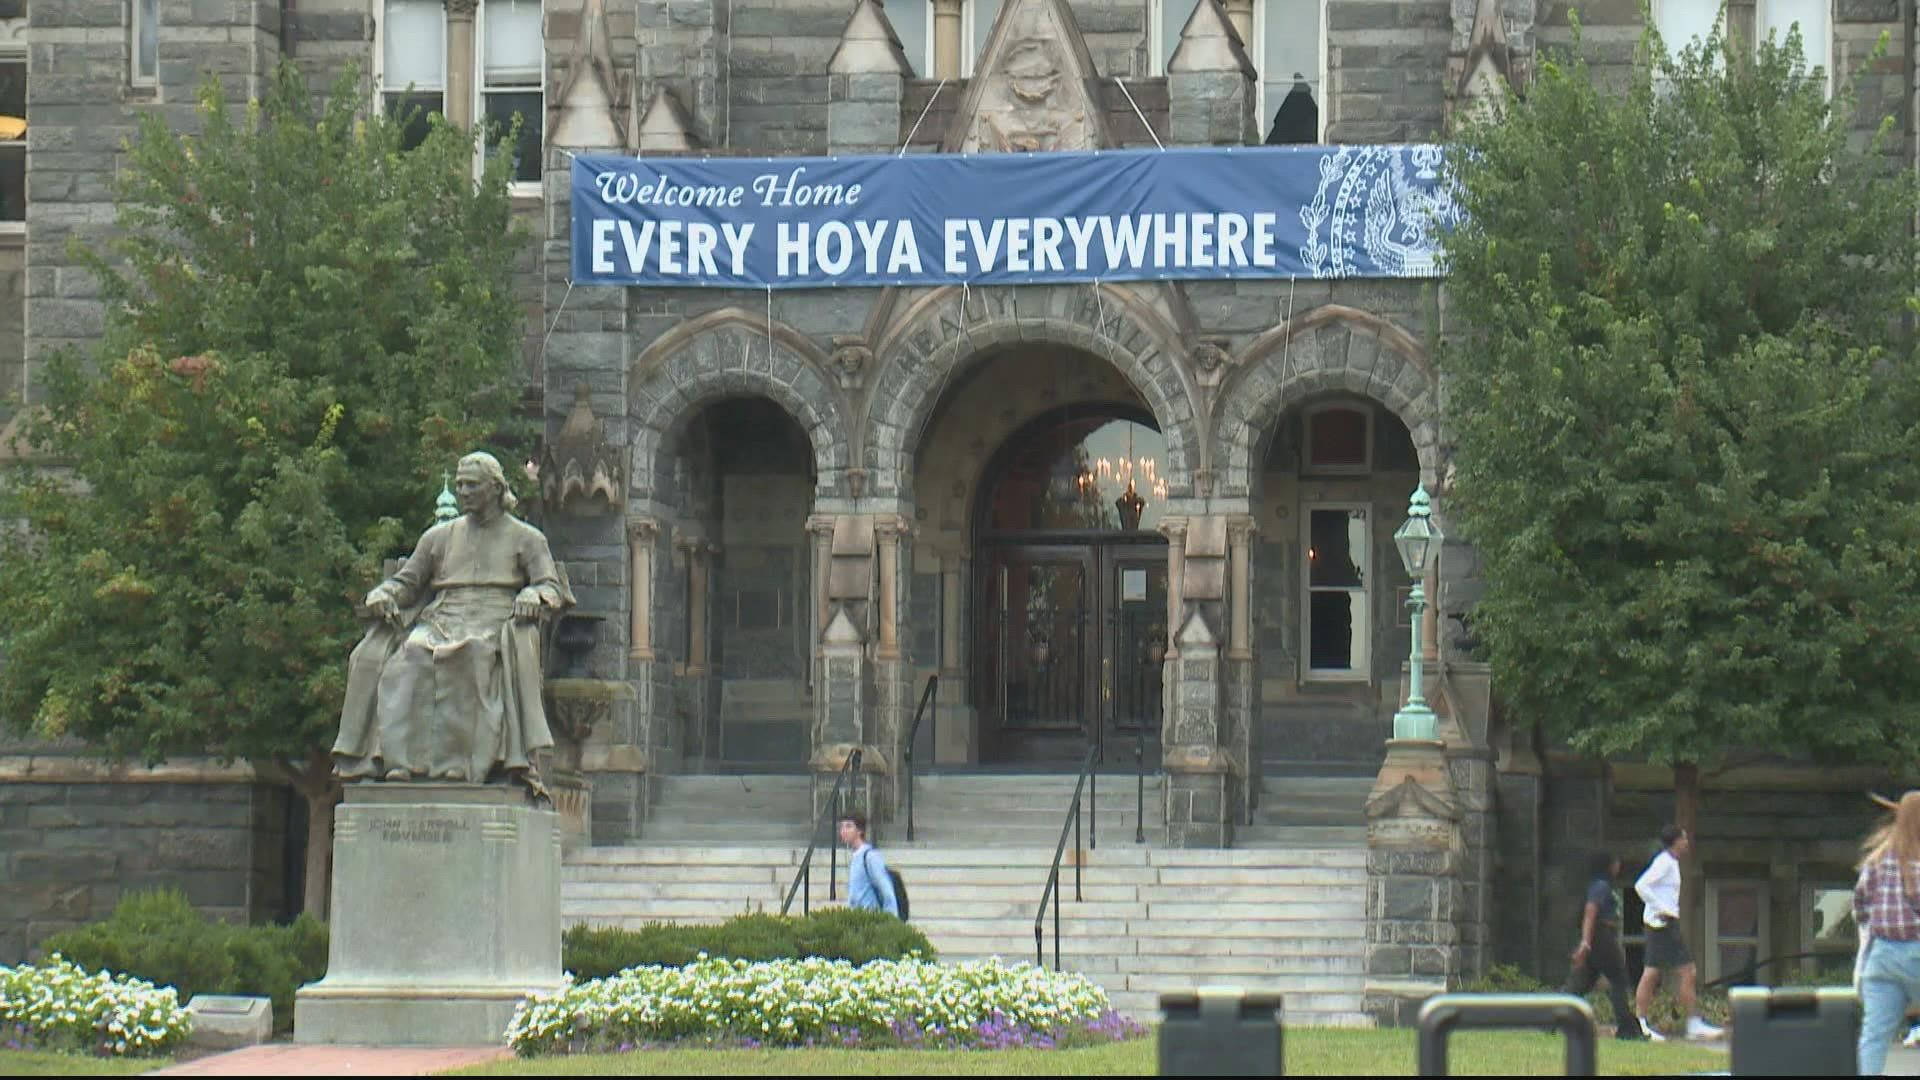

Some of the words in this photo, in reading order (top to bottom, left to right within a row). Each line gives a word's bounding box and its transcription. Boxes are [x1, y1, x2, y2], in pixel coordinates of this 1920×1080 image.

[595, 171, 744, 207] Welcome
[753, 167, 862, 207] Home
[592, 219, 755, 276] EVERY
[777, 219, 923, 276] HOYA
[944, 212, 1276, 274] EVERYWHERE
